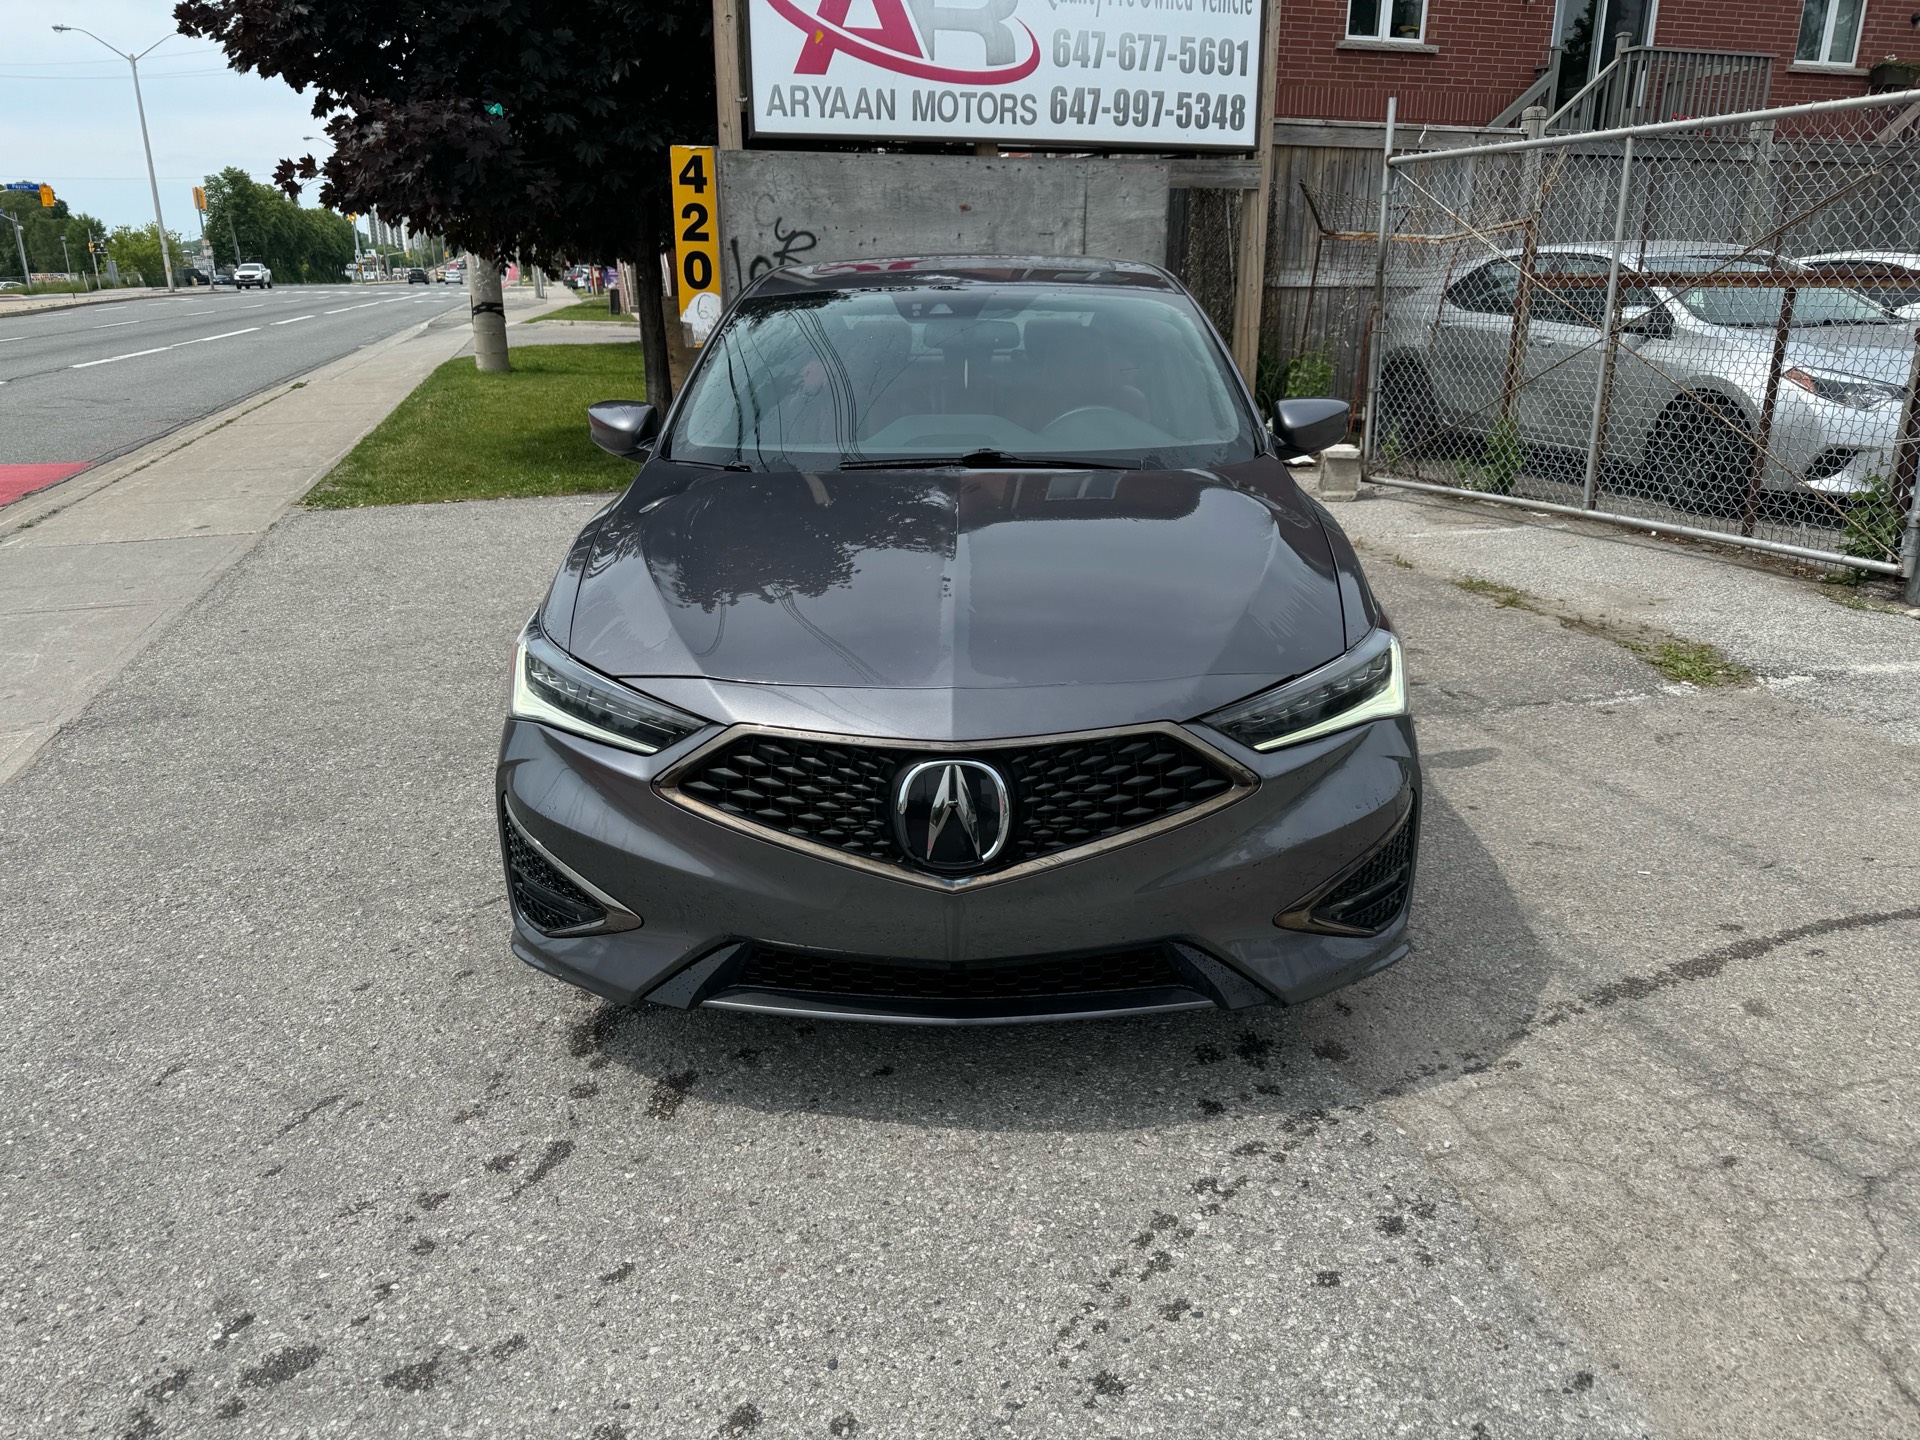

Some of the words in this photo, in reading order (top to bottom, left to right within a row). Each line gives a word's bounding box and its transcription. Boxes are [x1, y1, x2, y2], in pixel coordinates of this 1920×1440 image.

[1052, 28, 1249, 77] 647-677-5691
[765, 84, 896, 121] ARYAAN
[912, 89, 1038, 126] MOTORS
[1050, 85, 1246, 131] 647-997-5348
[678, 155, 713, 290] 420
